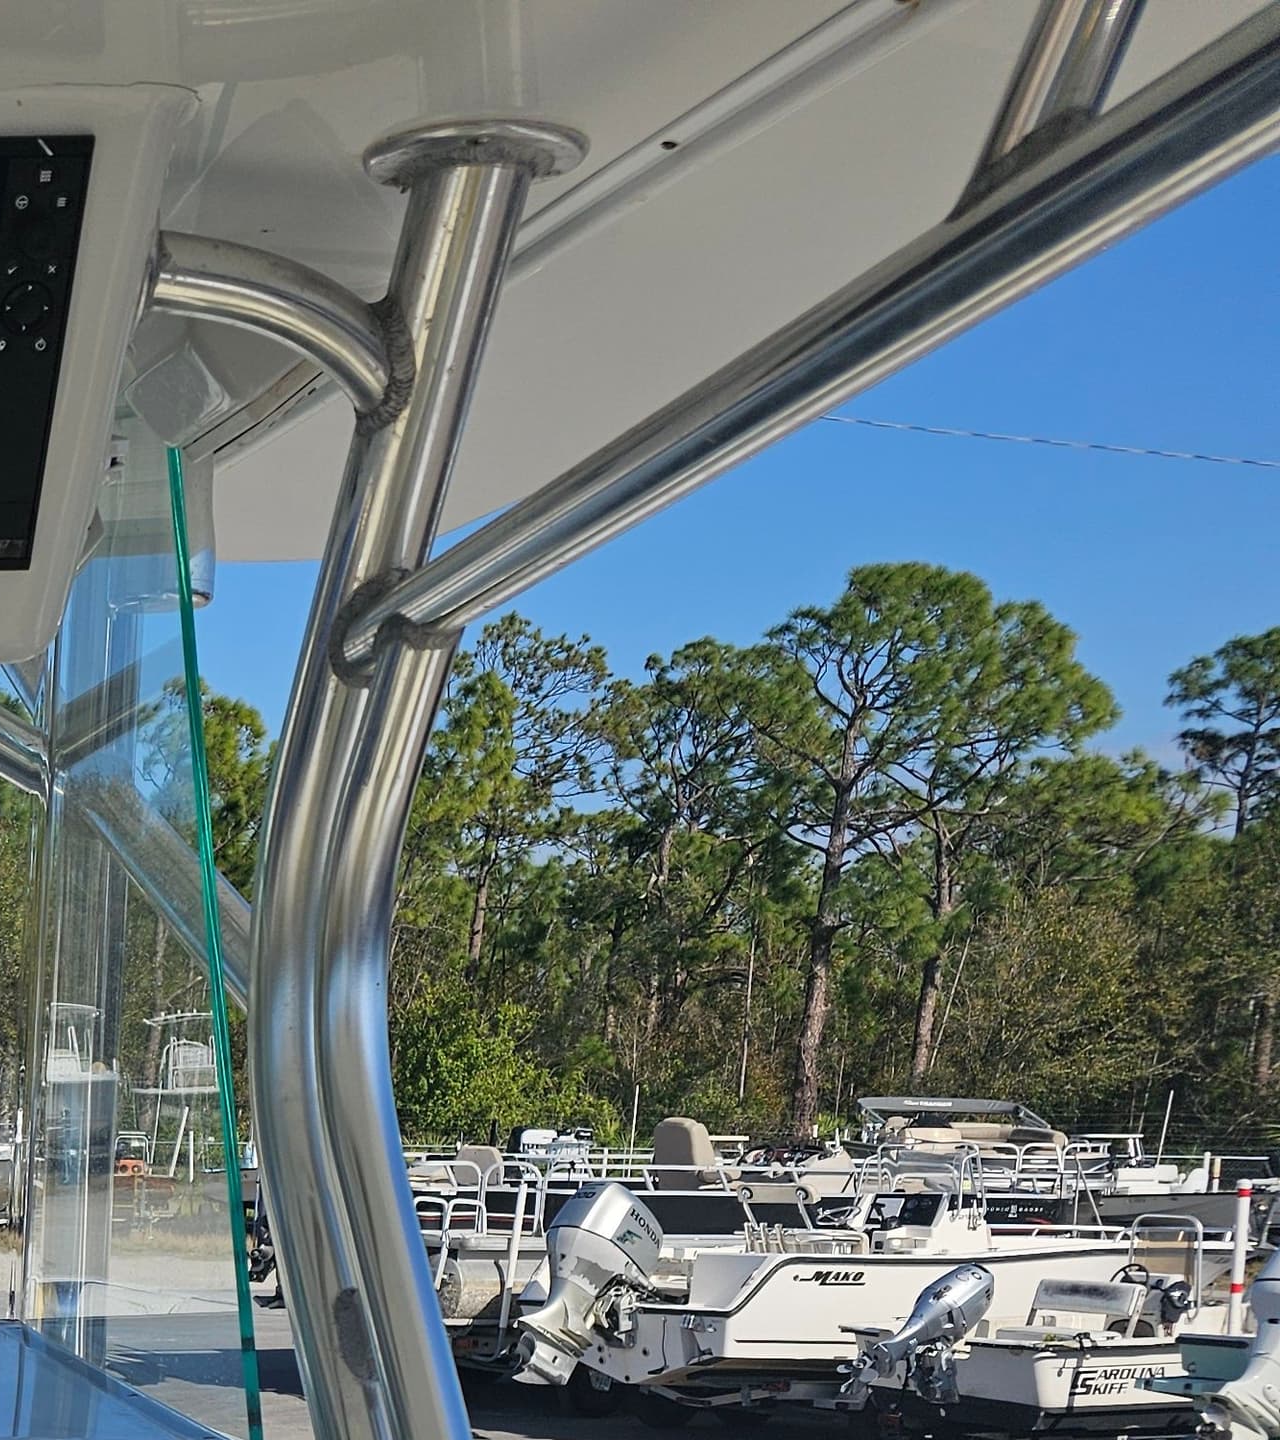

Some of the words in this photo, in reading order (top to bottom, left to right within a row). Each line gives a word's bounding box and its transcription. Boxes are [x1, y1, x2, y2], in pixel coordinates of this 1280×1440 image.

[629, 1207, 661, 1249] HONDA
[811, 1270, 866, 1286] MAKO
[1070, 1377, 1129, 1396] SKIFF
[1071, 1366, 1166, 1389] CAROLINA
